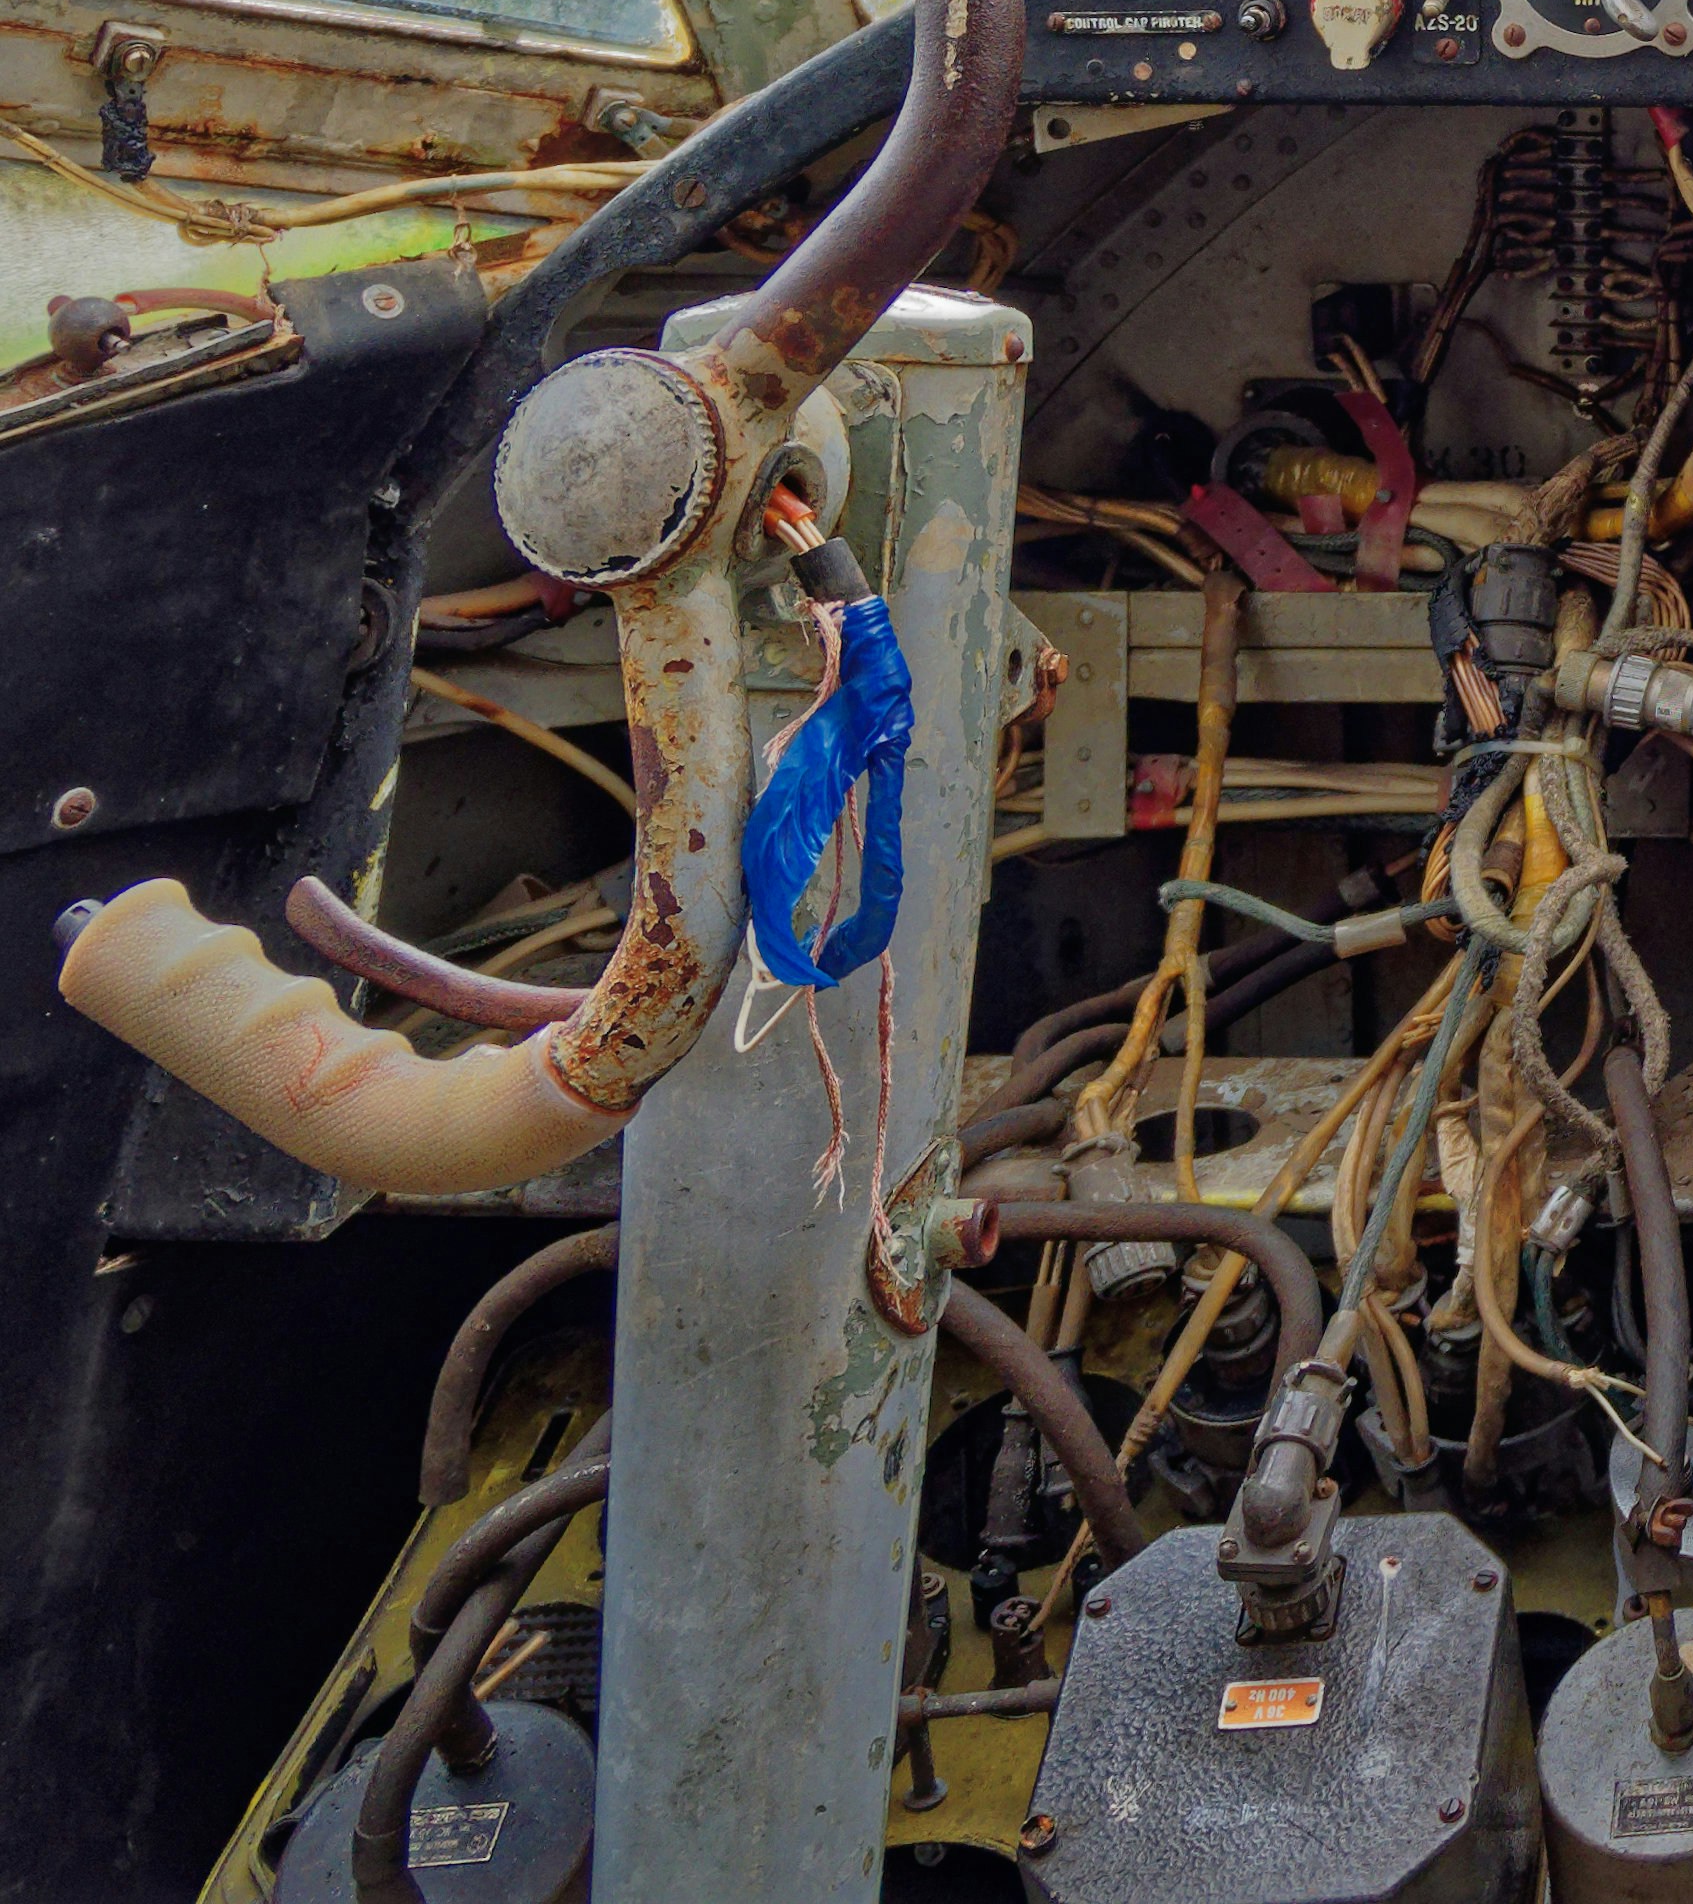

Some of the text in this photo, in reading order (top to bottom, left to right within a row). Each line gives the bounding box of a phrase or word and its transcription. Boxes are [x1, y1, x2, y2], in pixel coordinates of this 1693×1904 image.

[1067, 17, 1122, 29] CONTROL
[1248, 1688, 1297, 1702] 400 Hz
